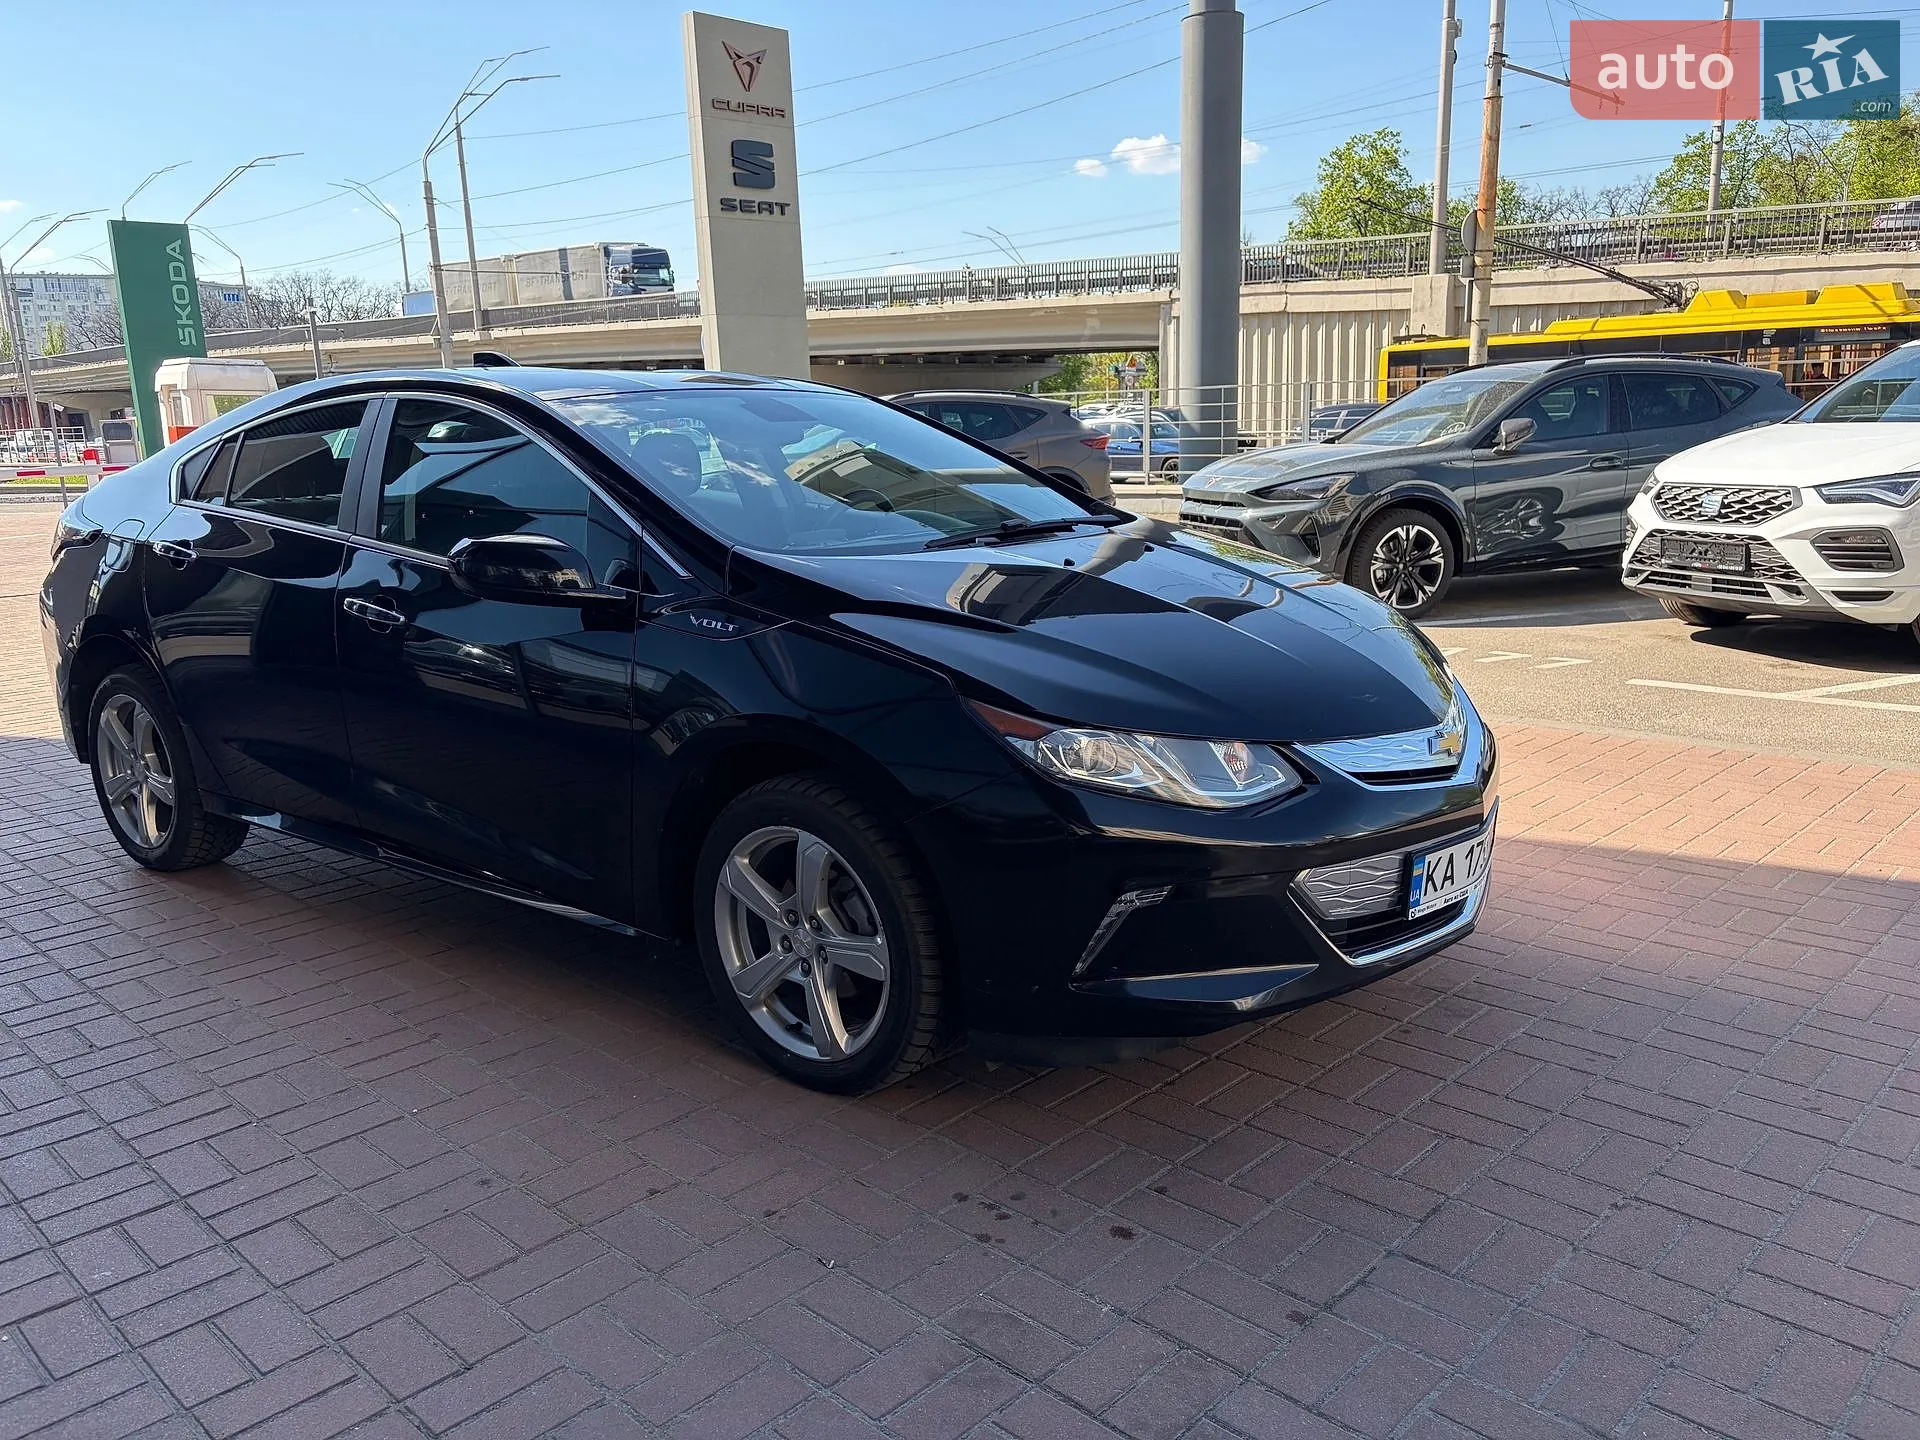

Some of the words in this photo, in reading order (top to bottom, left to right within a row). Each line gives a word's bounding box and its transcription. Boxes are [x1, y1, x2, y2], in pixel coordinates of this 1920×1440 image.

[711, 98, 786, 119] CUPRA
[720, 197, 791, 216] SEAT
[689, 612, 739, 632] VOLT
[1424, 853, 1455, 897] KA
[1410, 889, 1420, 902] UA
